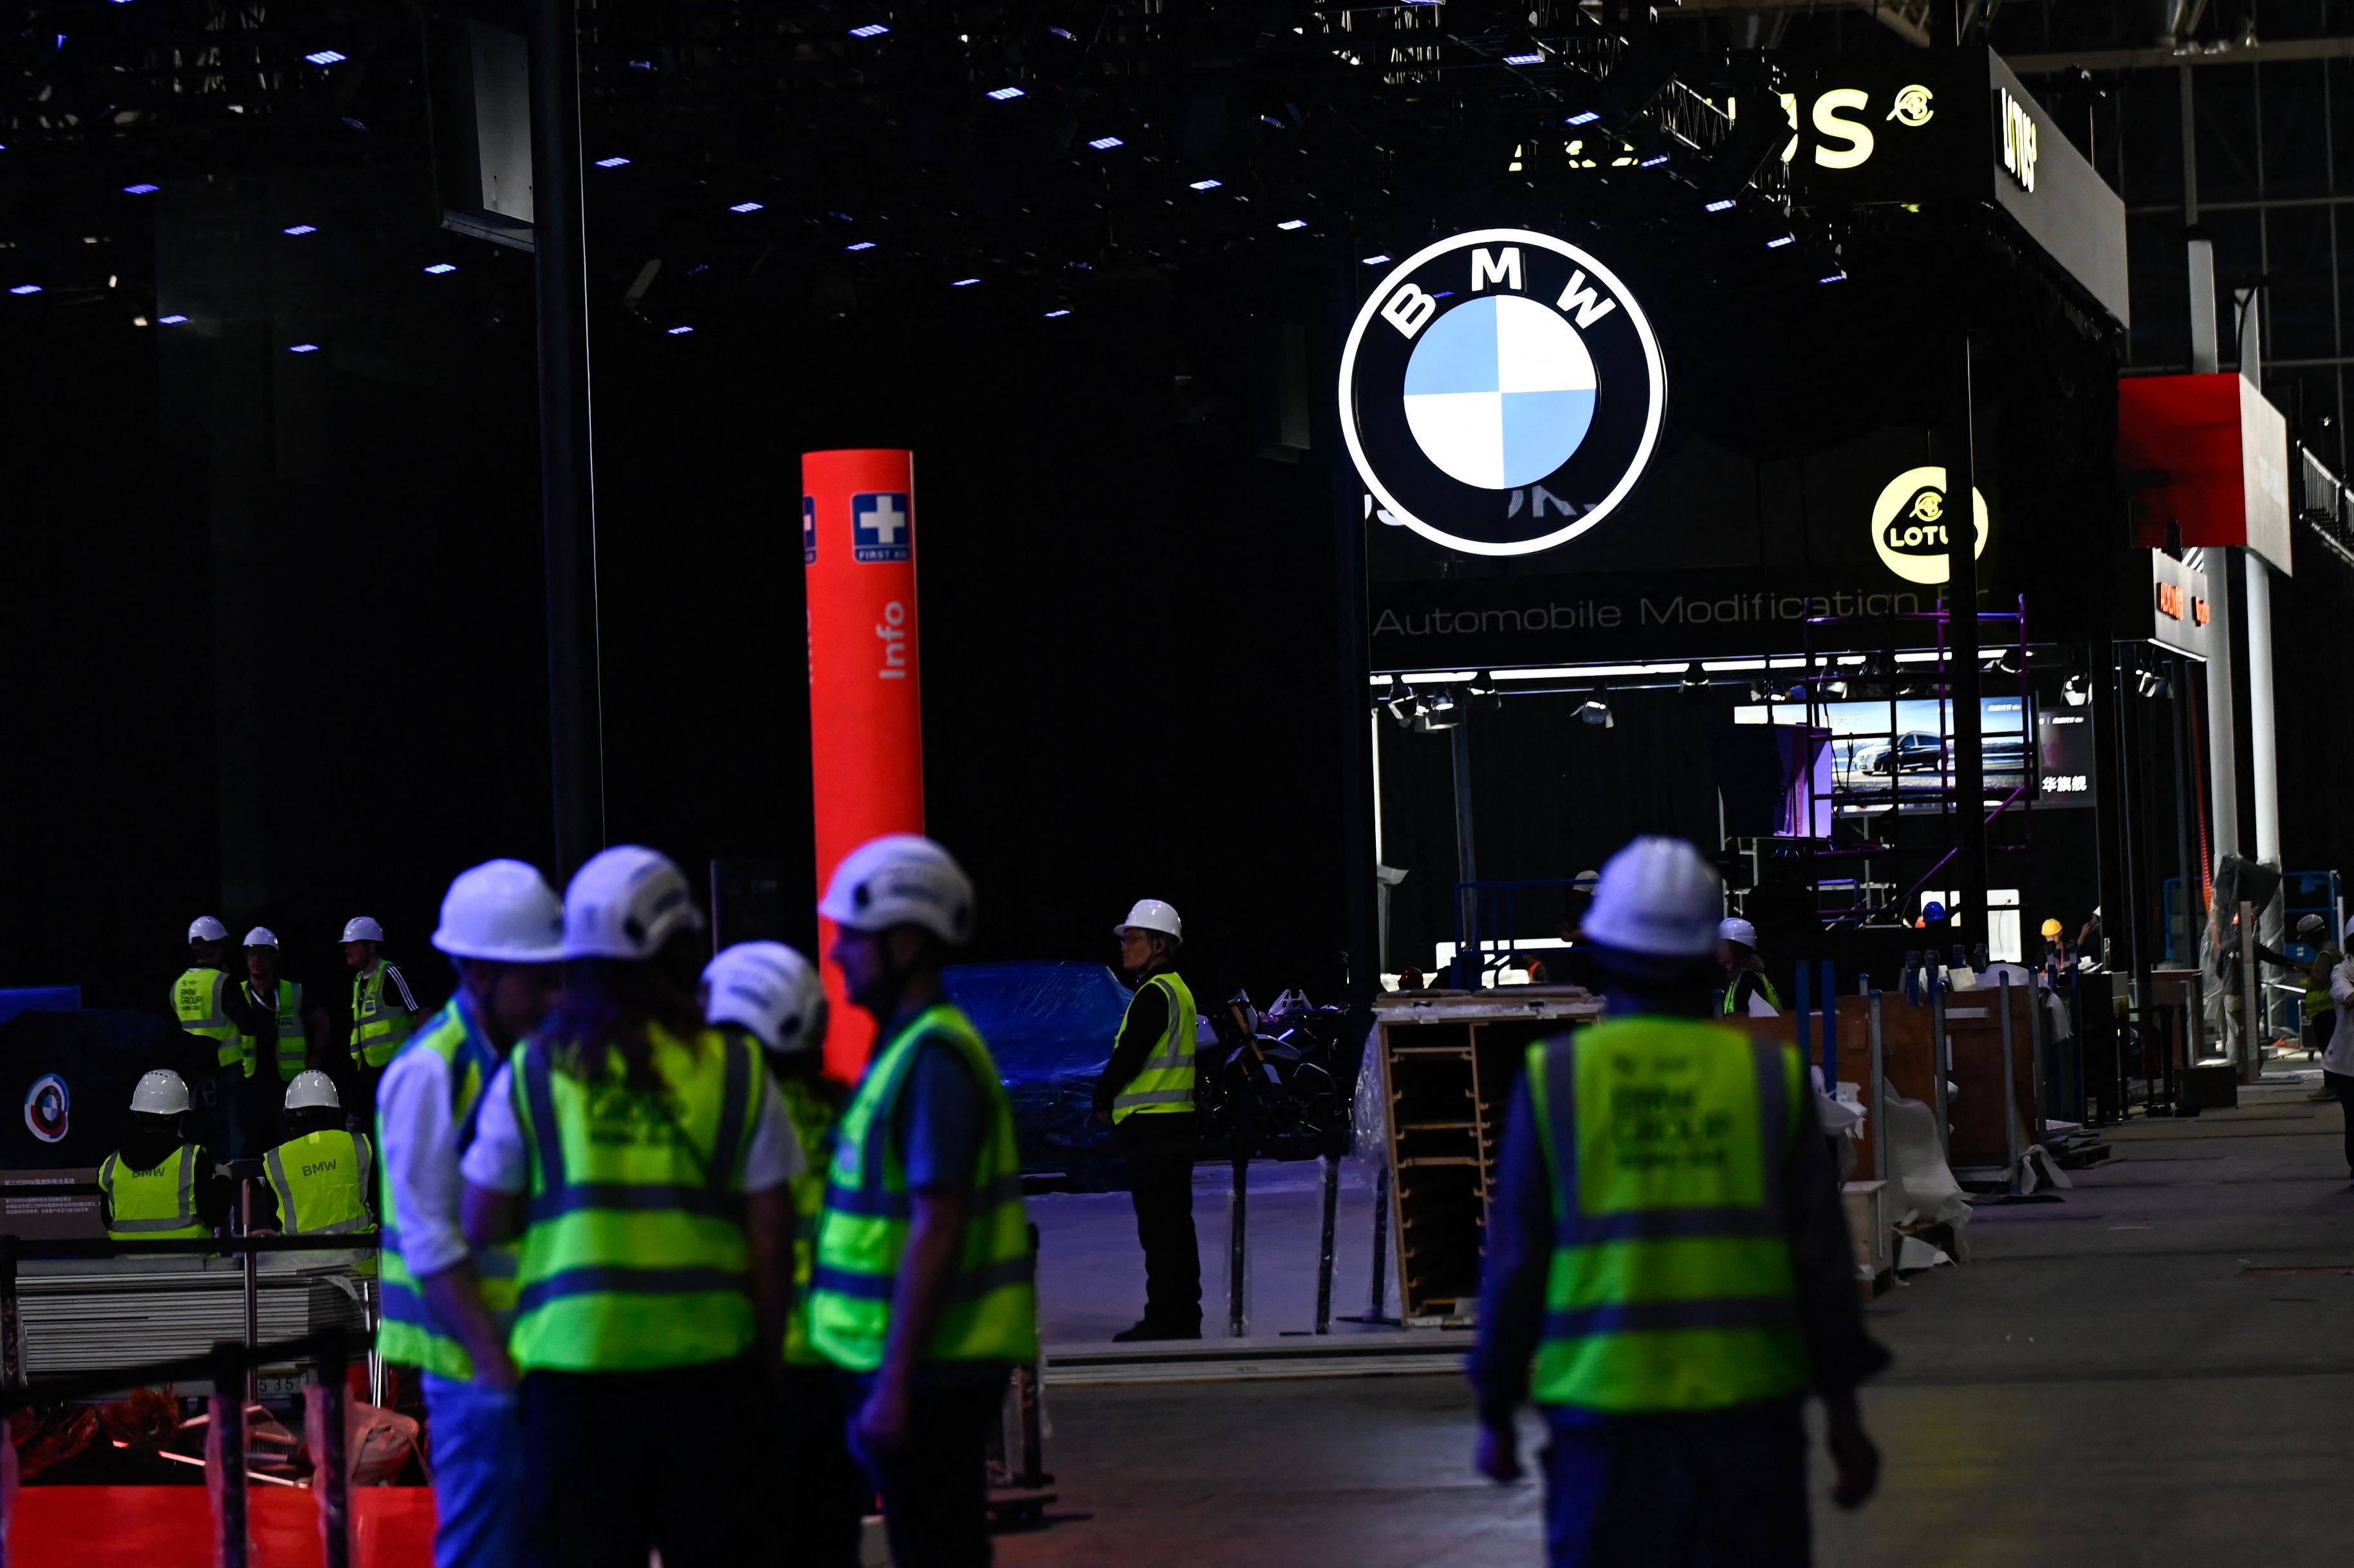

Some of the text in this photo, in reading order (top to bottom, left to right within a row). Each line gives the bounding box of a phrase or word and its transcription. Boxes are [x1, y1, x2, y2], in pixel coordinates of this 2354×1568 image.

[1380, 247, 1617, 340] BMW
[858, 549, 891, 560] FIRST
[1371, 600, 1622, 638] Automobile
[1640, 588, 1919, 625] Modification
[876, 601, 905, 679] Info
[302, 1159, 336, 1176] BMW
